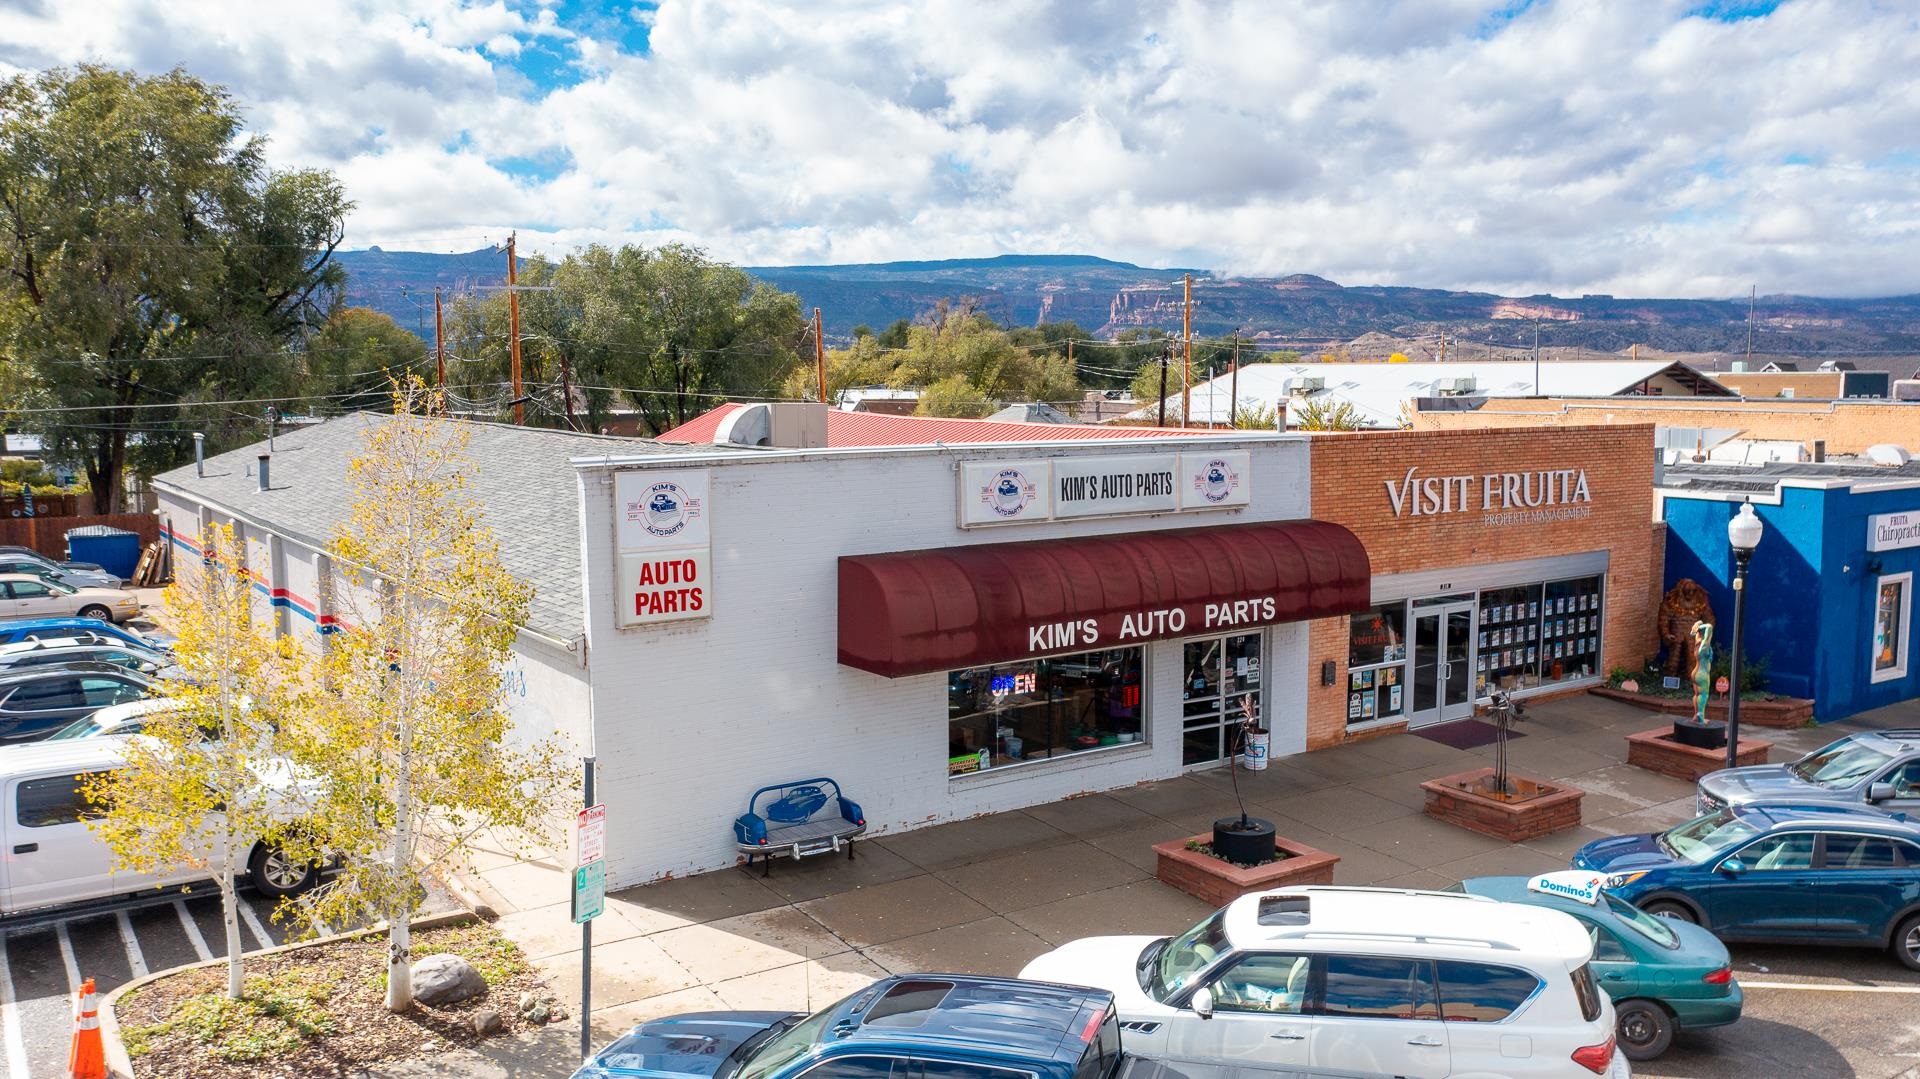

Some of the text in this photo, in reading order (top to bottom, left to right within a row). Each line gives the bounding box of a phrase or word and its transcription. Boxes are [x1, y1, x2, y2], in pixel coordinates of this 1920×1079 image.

[652, 484, 677, 492] KIM'S
[1061, 471, 1172, 501] KIM'S AUTO PARTS
[1384, 466, 1592, 518] VISIT FRUITA
[1484, 506, 1592, 527] PROPERTY MANAGEMENT
[1890, 515, 1908, 526] FRUITA
[647, 521, 684, 536] AUTO PARTS
[639, 559, 696, 586] AUTO
[636, 587, 703, 616] PARTS
[1029, 597, 1276, 651] KIM'S AUTO PARTS
[992, 673, 1036, 697] OPEN
[588, 810, 604, 820] PARKING
[1540, 879, 1592, 899] Domino's
